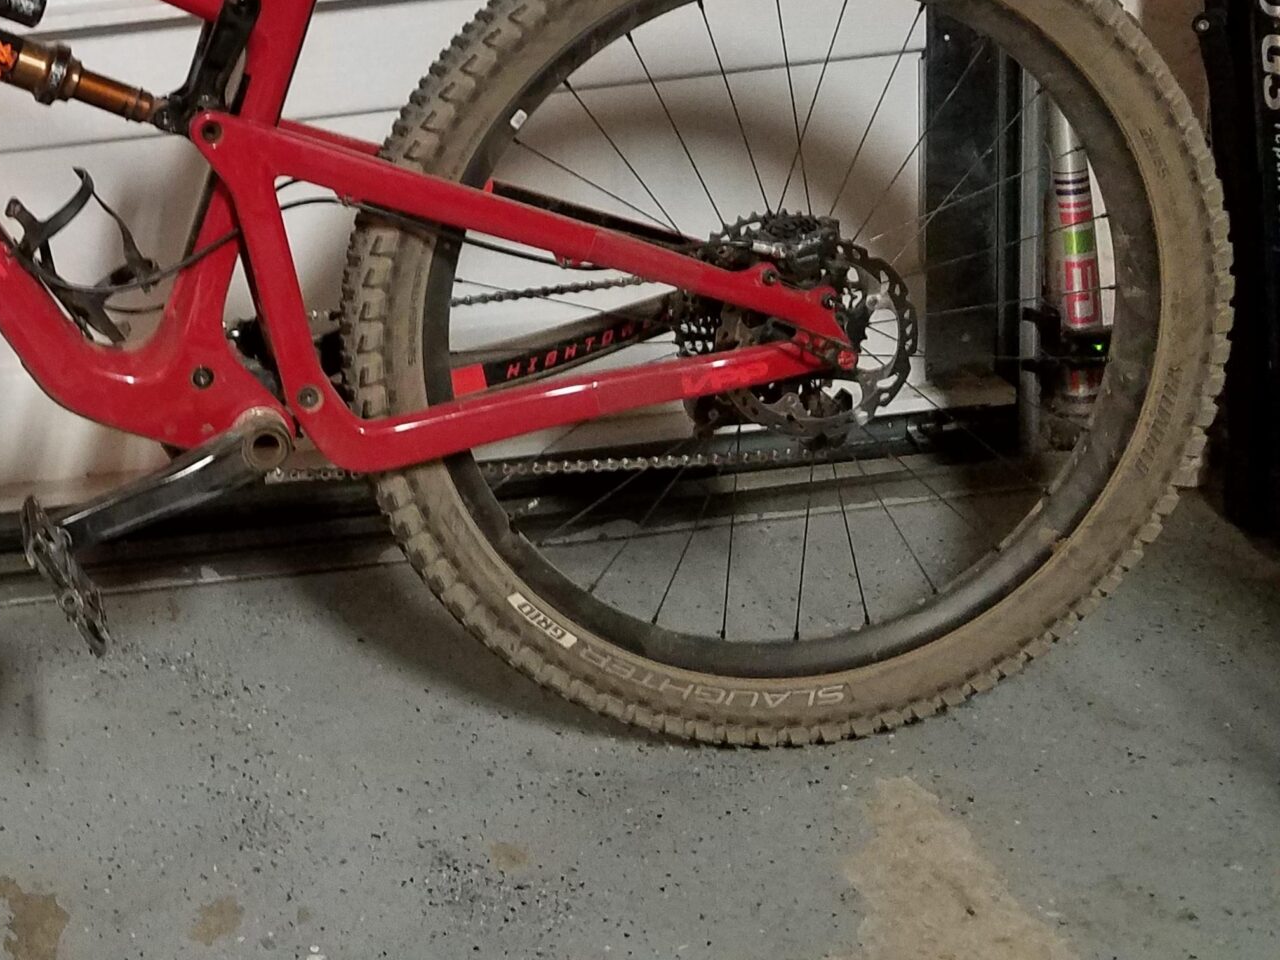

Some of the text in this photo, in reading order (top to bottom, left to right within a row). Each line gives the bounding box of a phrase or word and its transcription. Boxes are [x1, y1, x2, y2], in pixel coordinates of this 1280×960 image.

[681, 361, 769, 394] VPP
[514, 600, 846, 708] SLAUGHTER GRID
